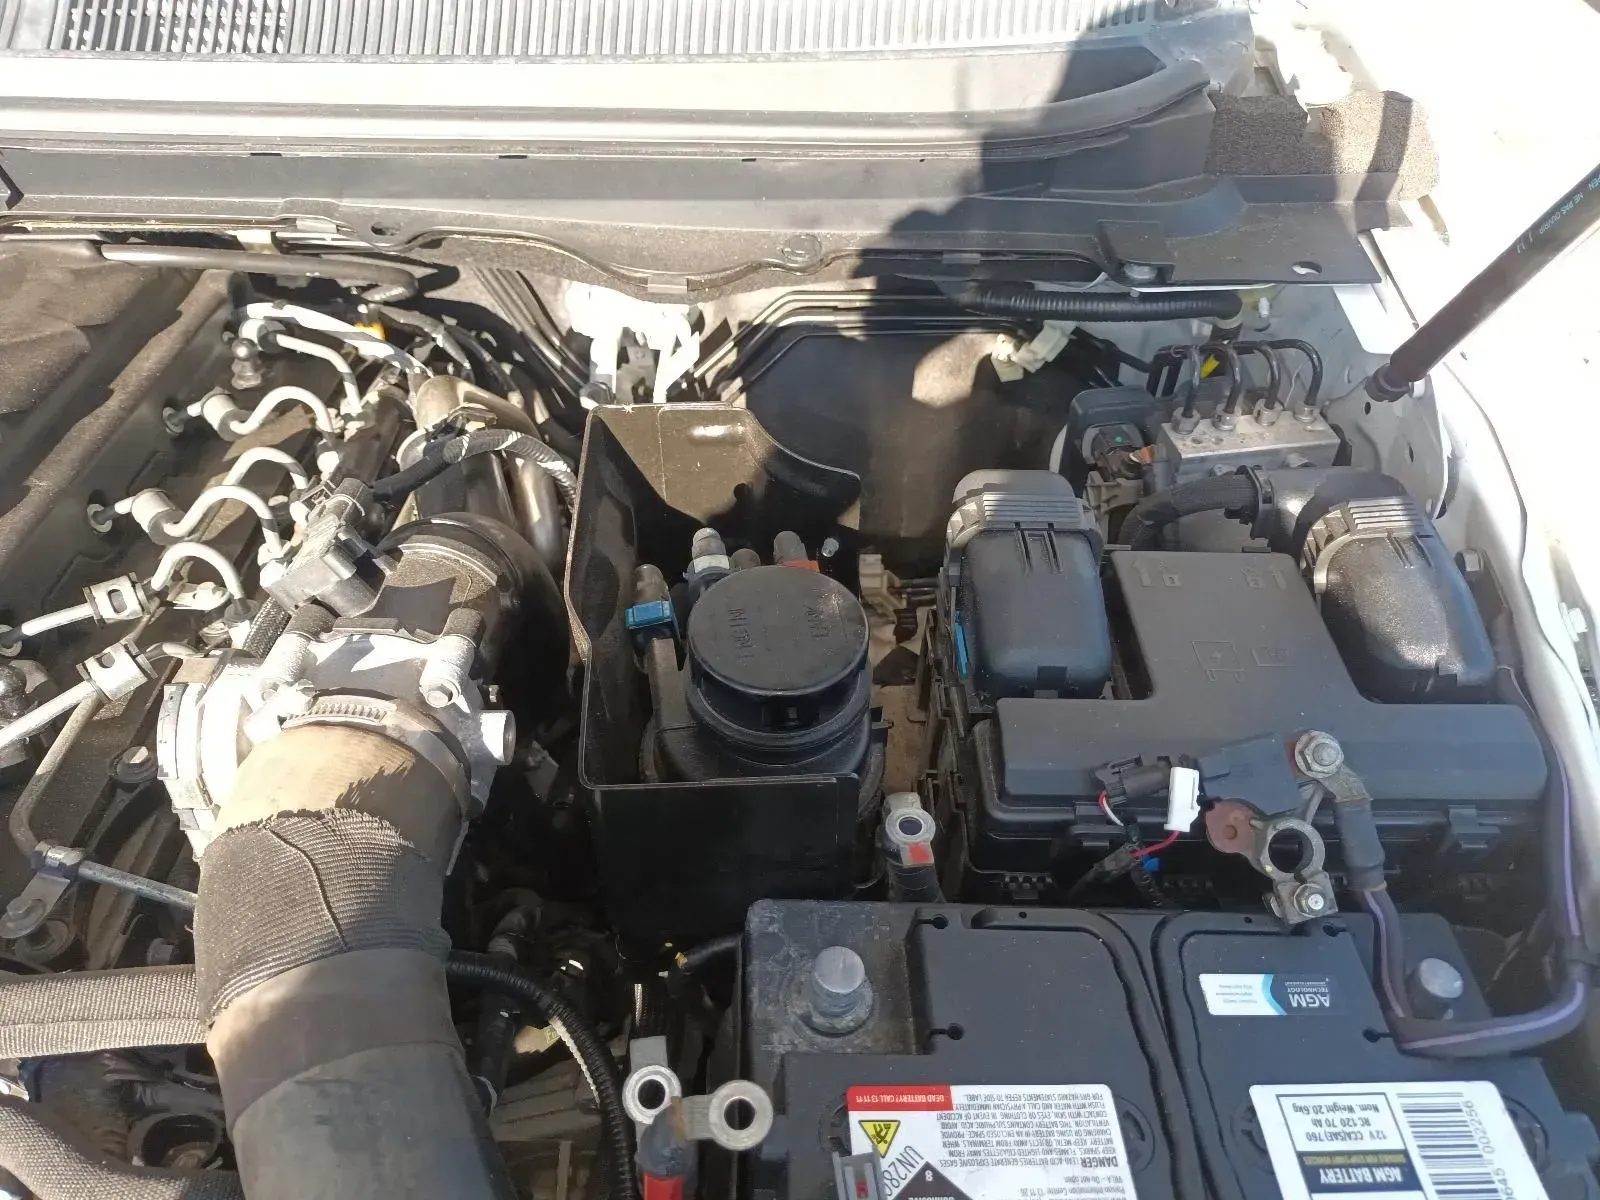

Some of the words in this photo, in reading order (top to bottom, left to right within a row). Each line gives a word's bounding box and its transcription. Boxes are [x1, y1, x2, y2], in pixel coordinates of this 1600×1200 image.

[1560, 201, 1574, 215] PAS
[1289, 994, 1329, 1007] AGM
[880, 1095, 895, 1103] CALL
[896, 1095, 926, 1103] BATTERY?
[927, 1095, 944, 1103] DEAD
[1292, 1103, 1324, 1115] 20.6kg
[1326, 1102, 1355, 1114] Weight
[1356, 1104, 1380, 1113] Nom.
[936, 1113, 962, 1121] ACCIDENT
[965, 1112, 971, 1120] OF
[1311, 1118, 1322, 1128] Ah
[1325, 1118, 1338, 1128] 70
[1340, 1118, 1357, 1127] 120
[1358, 1117, 1371, 1126] RC
[1305, 1132, 1323, 1142] 760
[1324, 1130, 1364, 1141] CCA(SAE)
[1369, 1130, 1387, 1140] 12V
[942, 1140, 960, 1148] WHEN
[1054, 1139, 1072, 1147] METAL
[948, 1150, 965, 1158] FROM
[967, 1149, 981, 1158] AWAY
[959, 1158, 990, 1167] EXPLOSIVE
[1080, 1157, 1118, 1168] DANGER
[925, 1170, 933, 1181] 8
[1319, 1168, 1373, 1184] BATTERY
[1372, 1167, 1402, 1182] AGM
